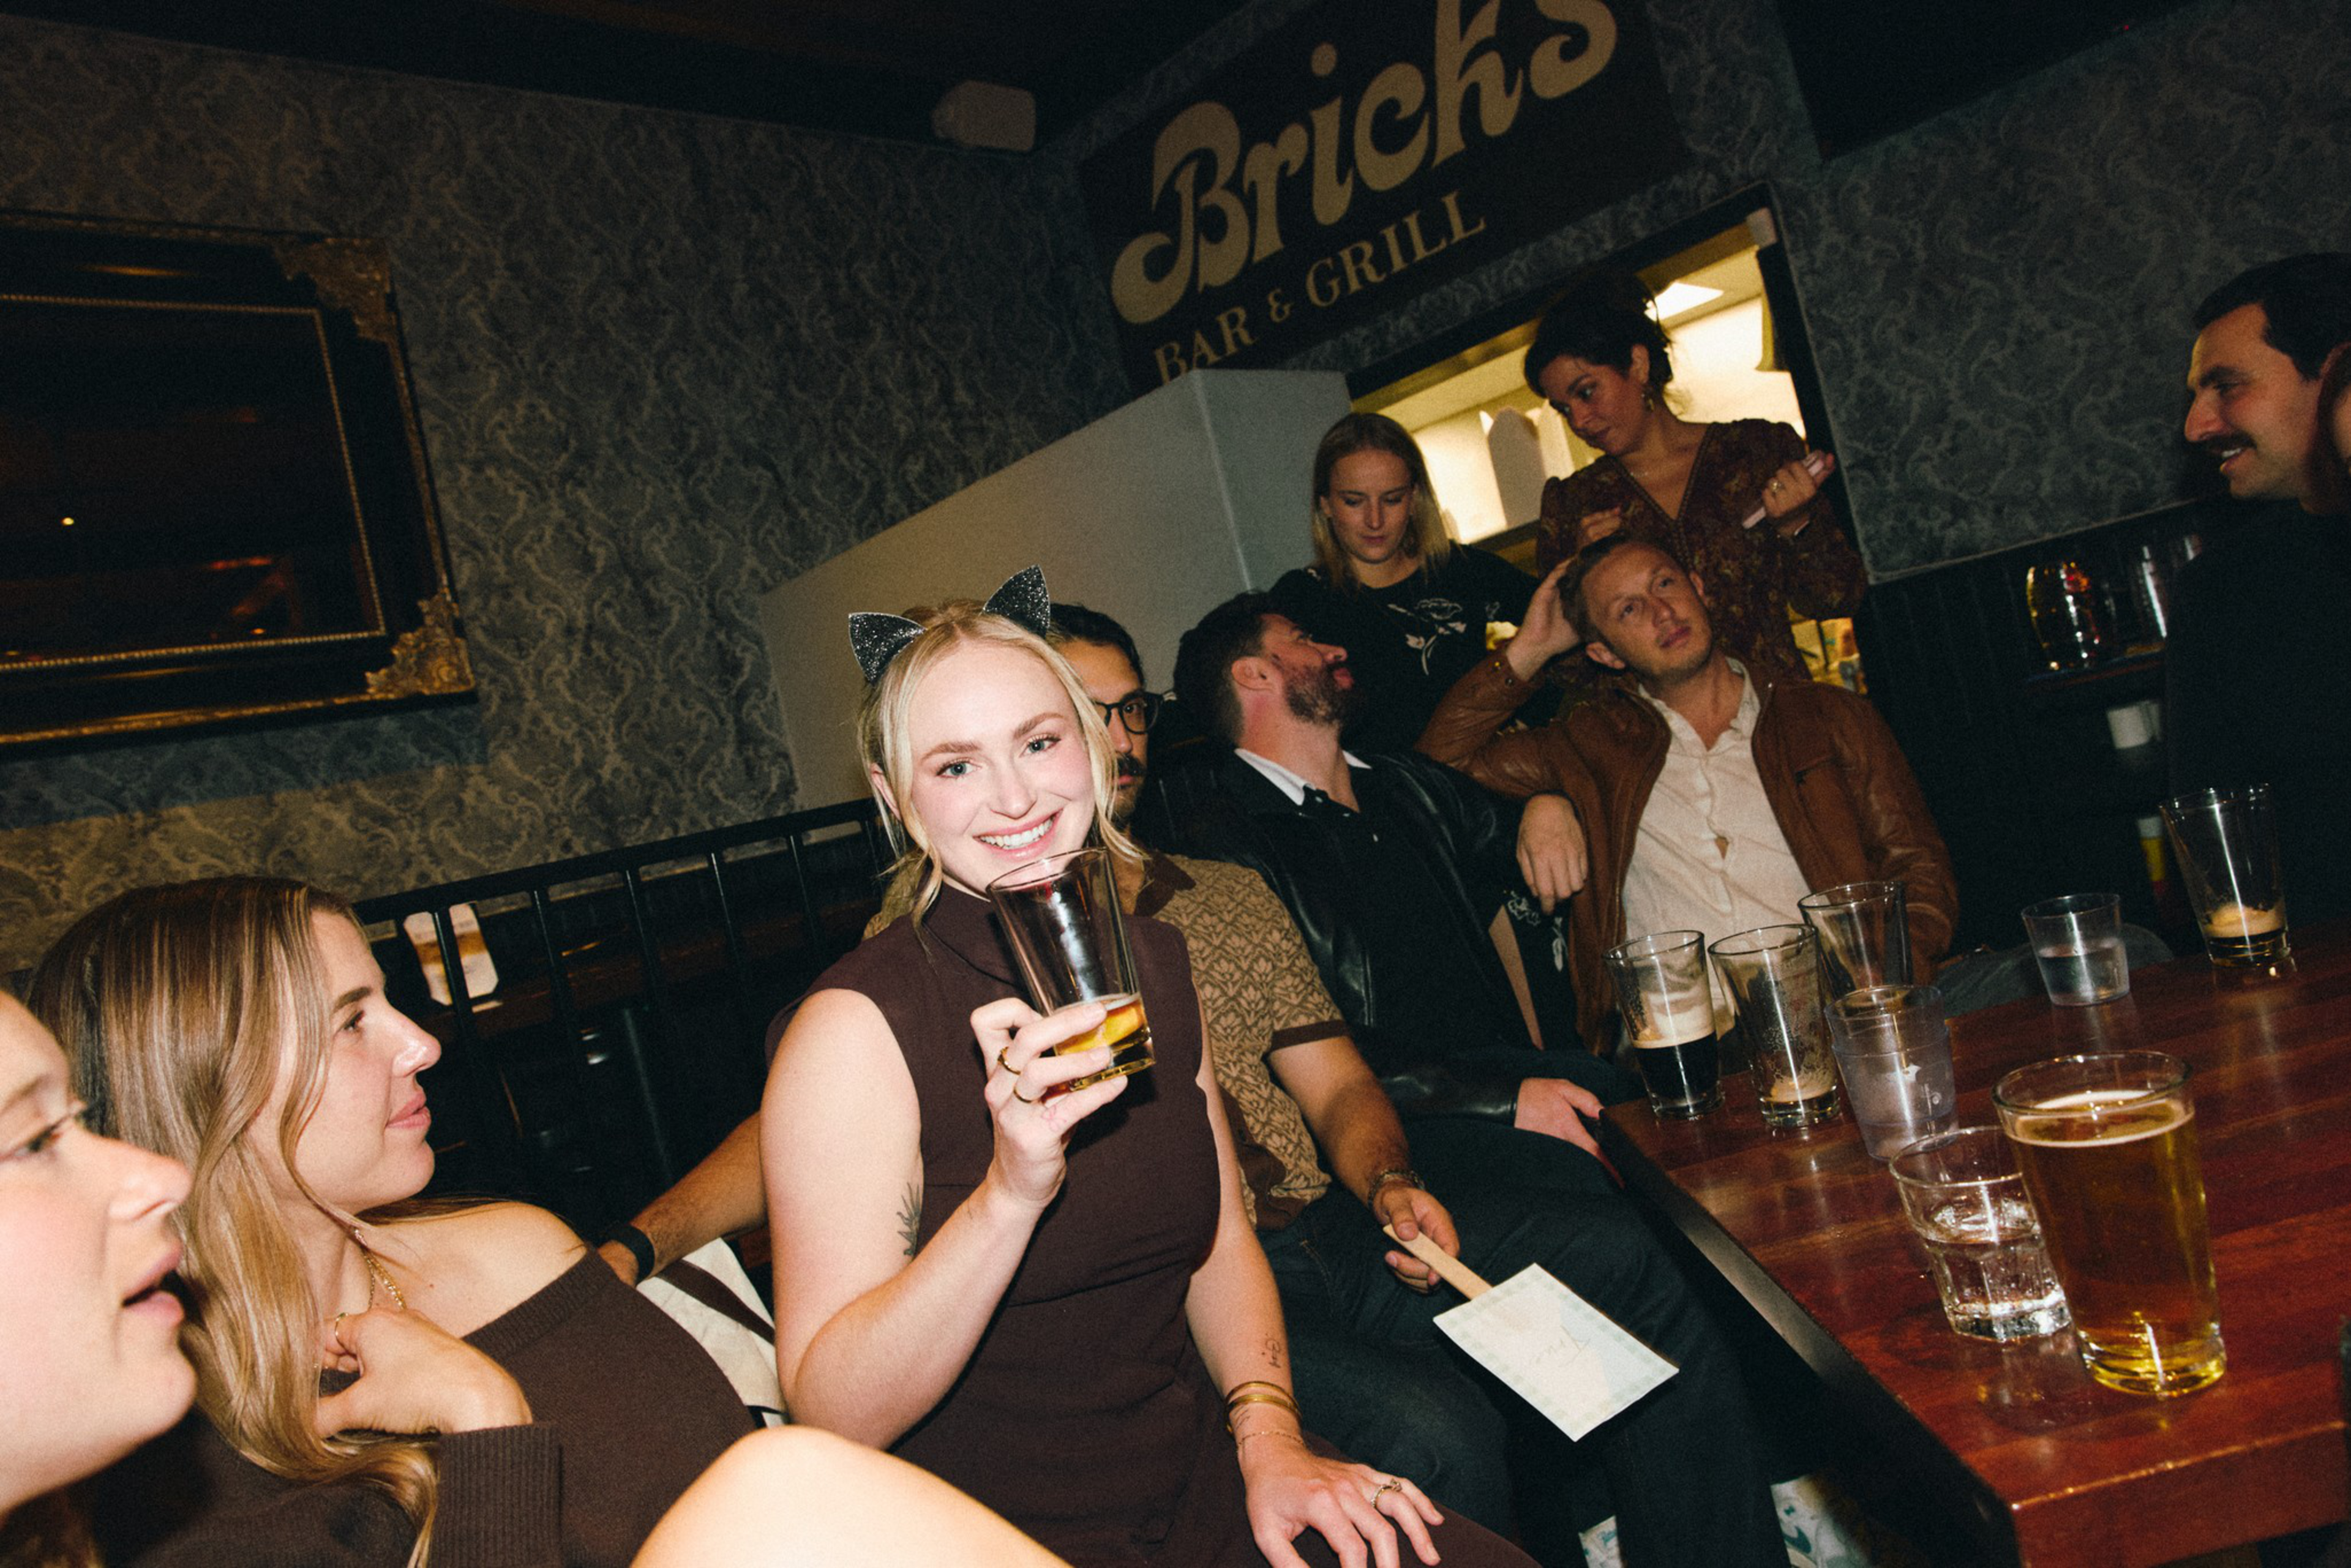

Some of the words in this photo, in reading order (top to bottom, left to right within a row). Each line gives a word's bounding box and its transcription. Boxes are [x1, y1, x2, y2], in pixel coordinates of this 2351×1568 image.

[1154, 307, 1258, 384] BAR
[1267, 288, 1294, 323] &
[1305, 190, 1486, 306] GRILL
